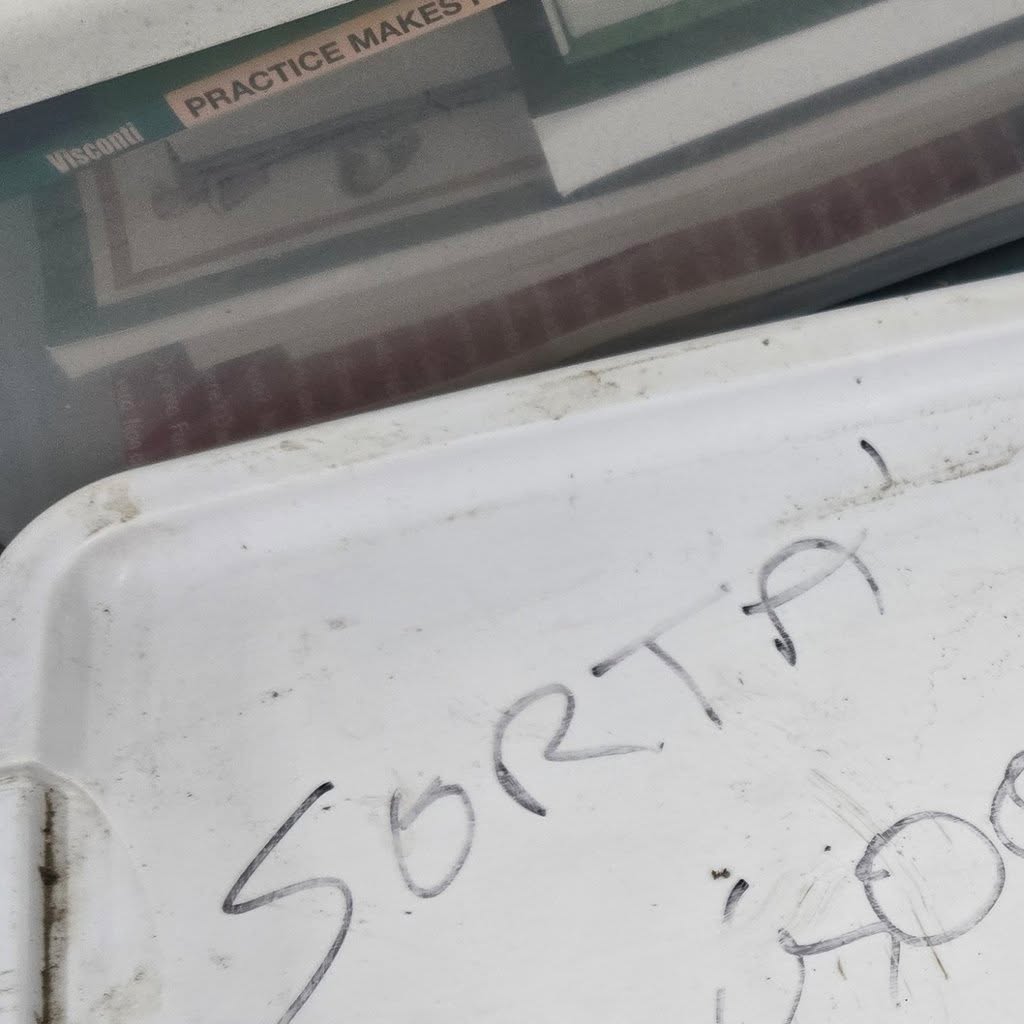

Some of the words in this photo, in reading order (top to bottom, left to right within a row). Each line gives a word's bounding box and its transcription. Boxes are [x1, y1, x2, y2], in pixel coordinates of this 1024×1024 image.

[183, 40, 346, 119] PRACTICE
[348, 0, 463, 54] MAKES
[46, 121, 145, 174] Visconti
